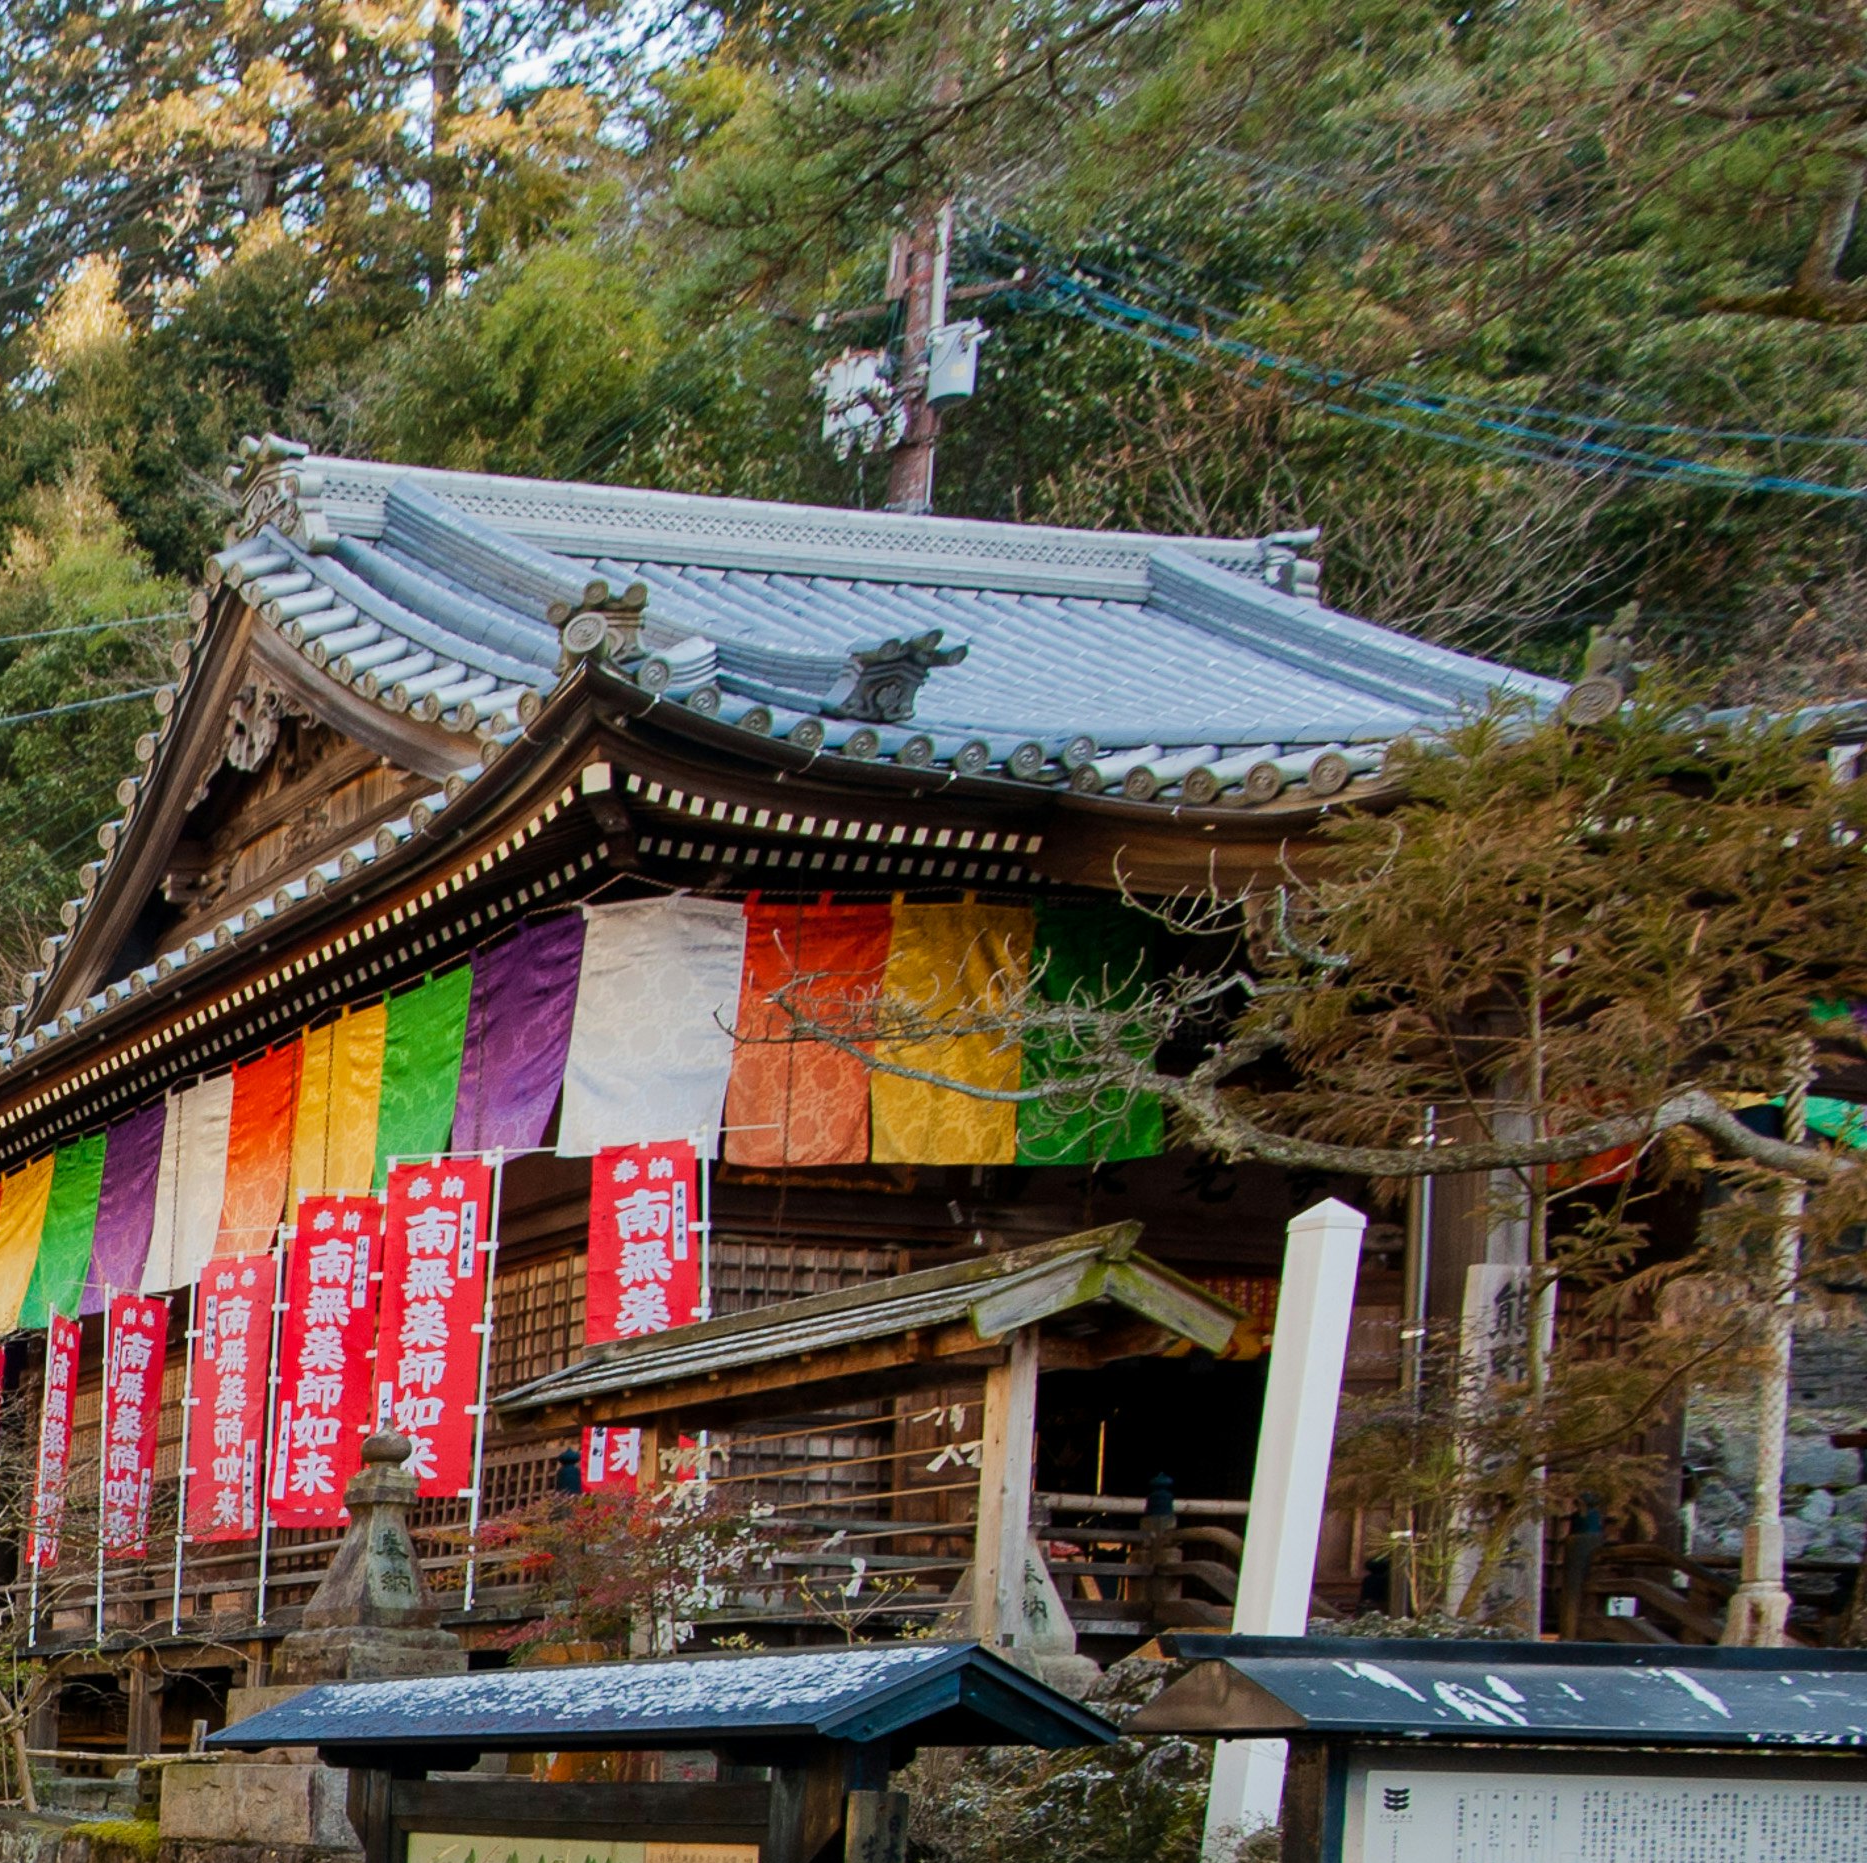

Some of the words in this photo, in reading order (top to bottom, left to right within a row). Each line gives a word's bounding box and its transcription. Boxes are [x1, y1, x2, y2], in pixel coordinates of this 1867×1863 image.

[407, 1175, 466, 1200] 奉納
[612, 1156, 674, 1183] 奉納
[289, 1238, 354, 1497] 南無薬師如来
[394, 1206, 457, 1479] 南無薬師如来
[375, 1529, 413, 1594] 奉納
